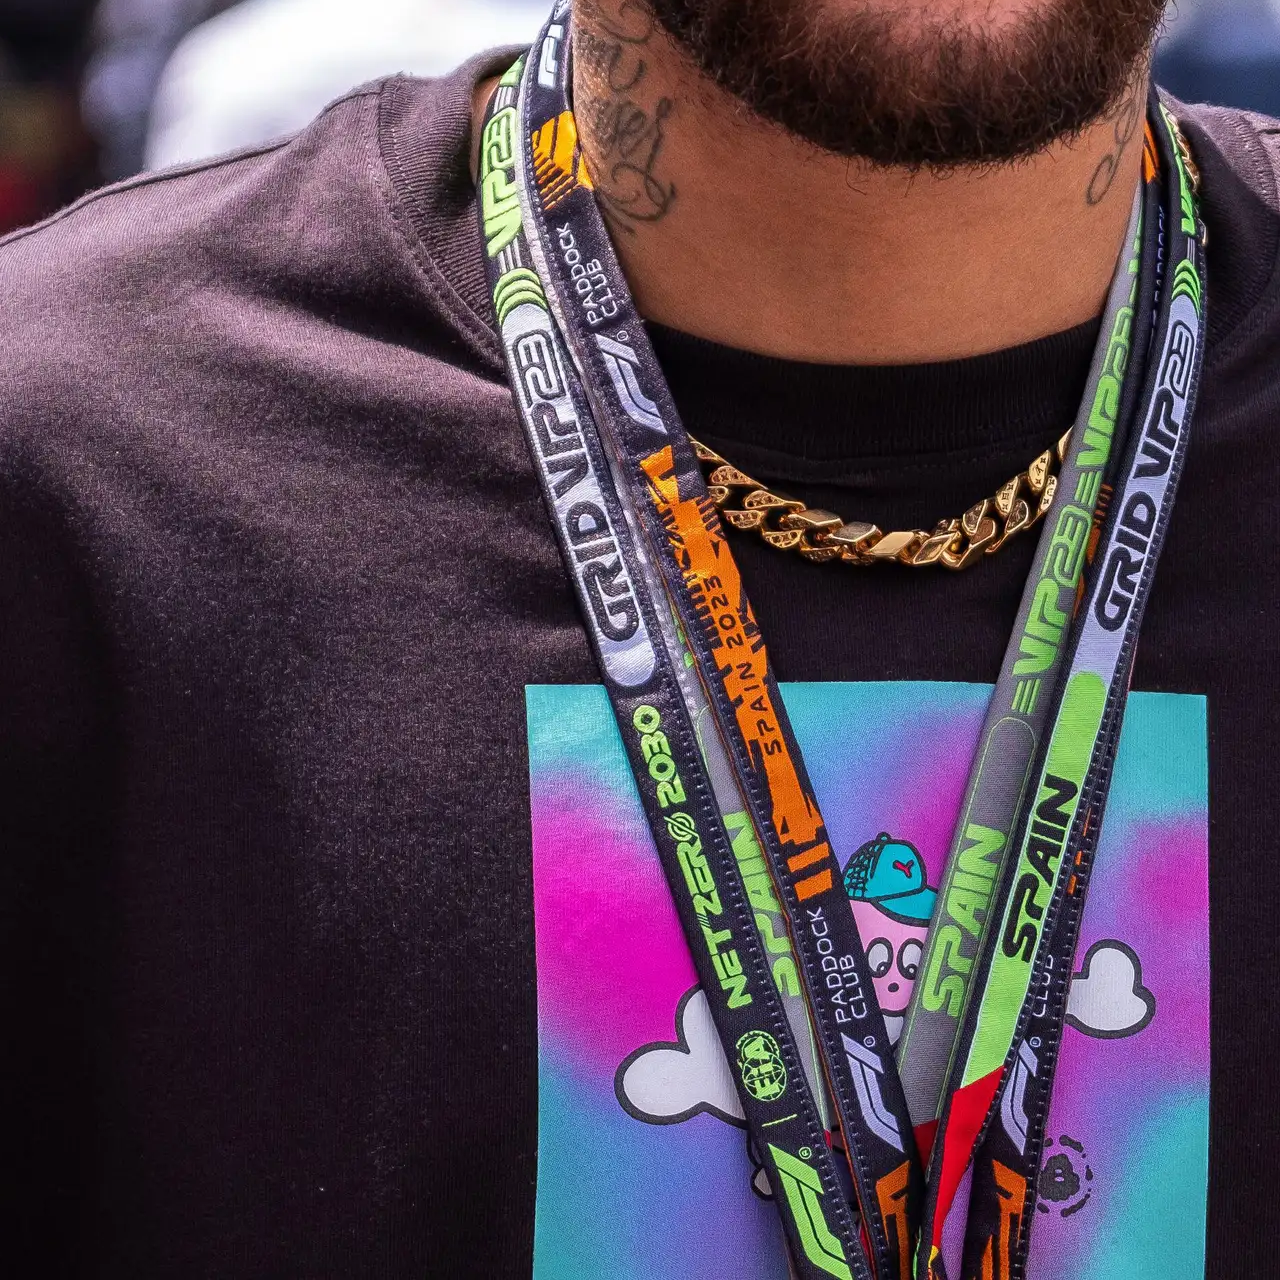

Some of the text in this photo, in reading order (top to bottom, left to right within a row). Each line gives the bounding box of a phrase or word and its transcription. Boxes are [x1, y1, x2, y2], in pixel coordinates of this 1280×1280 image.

[556, 222, 603, 325] PADDOCK
[586, 258, 619, 318] CLUB
[512, 328, 640, 642] GRID VIP23
[1094, 320, 1195, 632] GRID VIP23
[703, 574, 783, 756] SPAIN 2023
[1013, 504, 1093, 677] VIP23
[632, 704, 687, 809] 2030
[723, 810, 802, 997] SPAIN
[922, 822, 1006, 1018] SPAIN
[1002, 773, 1078, 963] SPAIN
[806, 906, 852, 1023] PADDOCK
[839, 954, 868, 1019] CLUB
